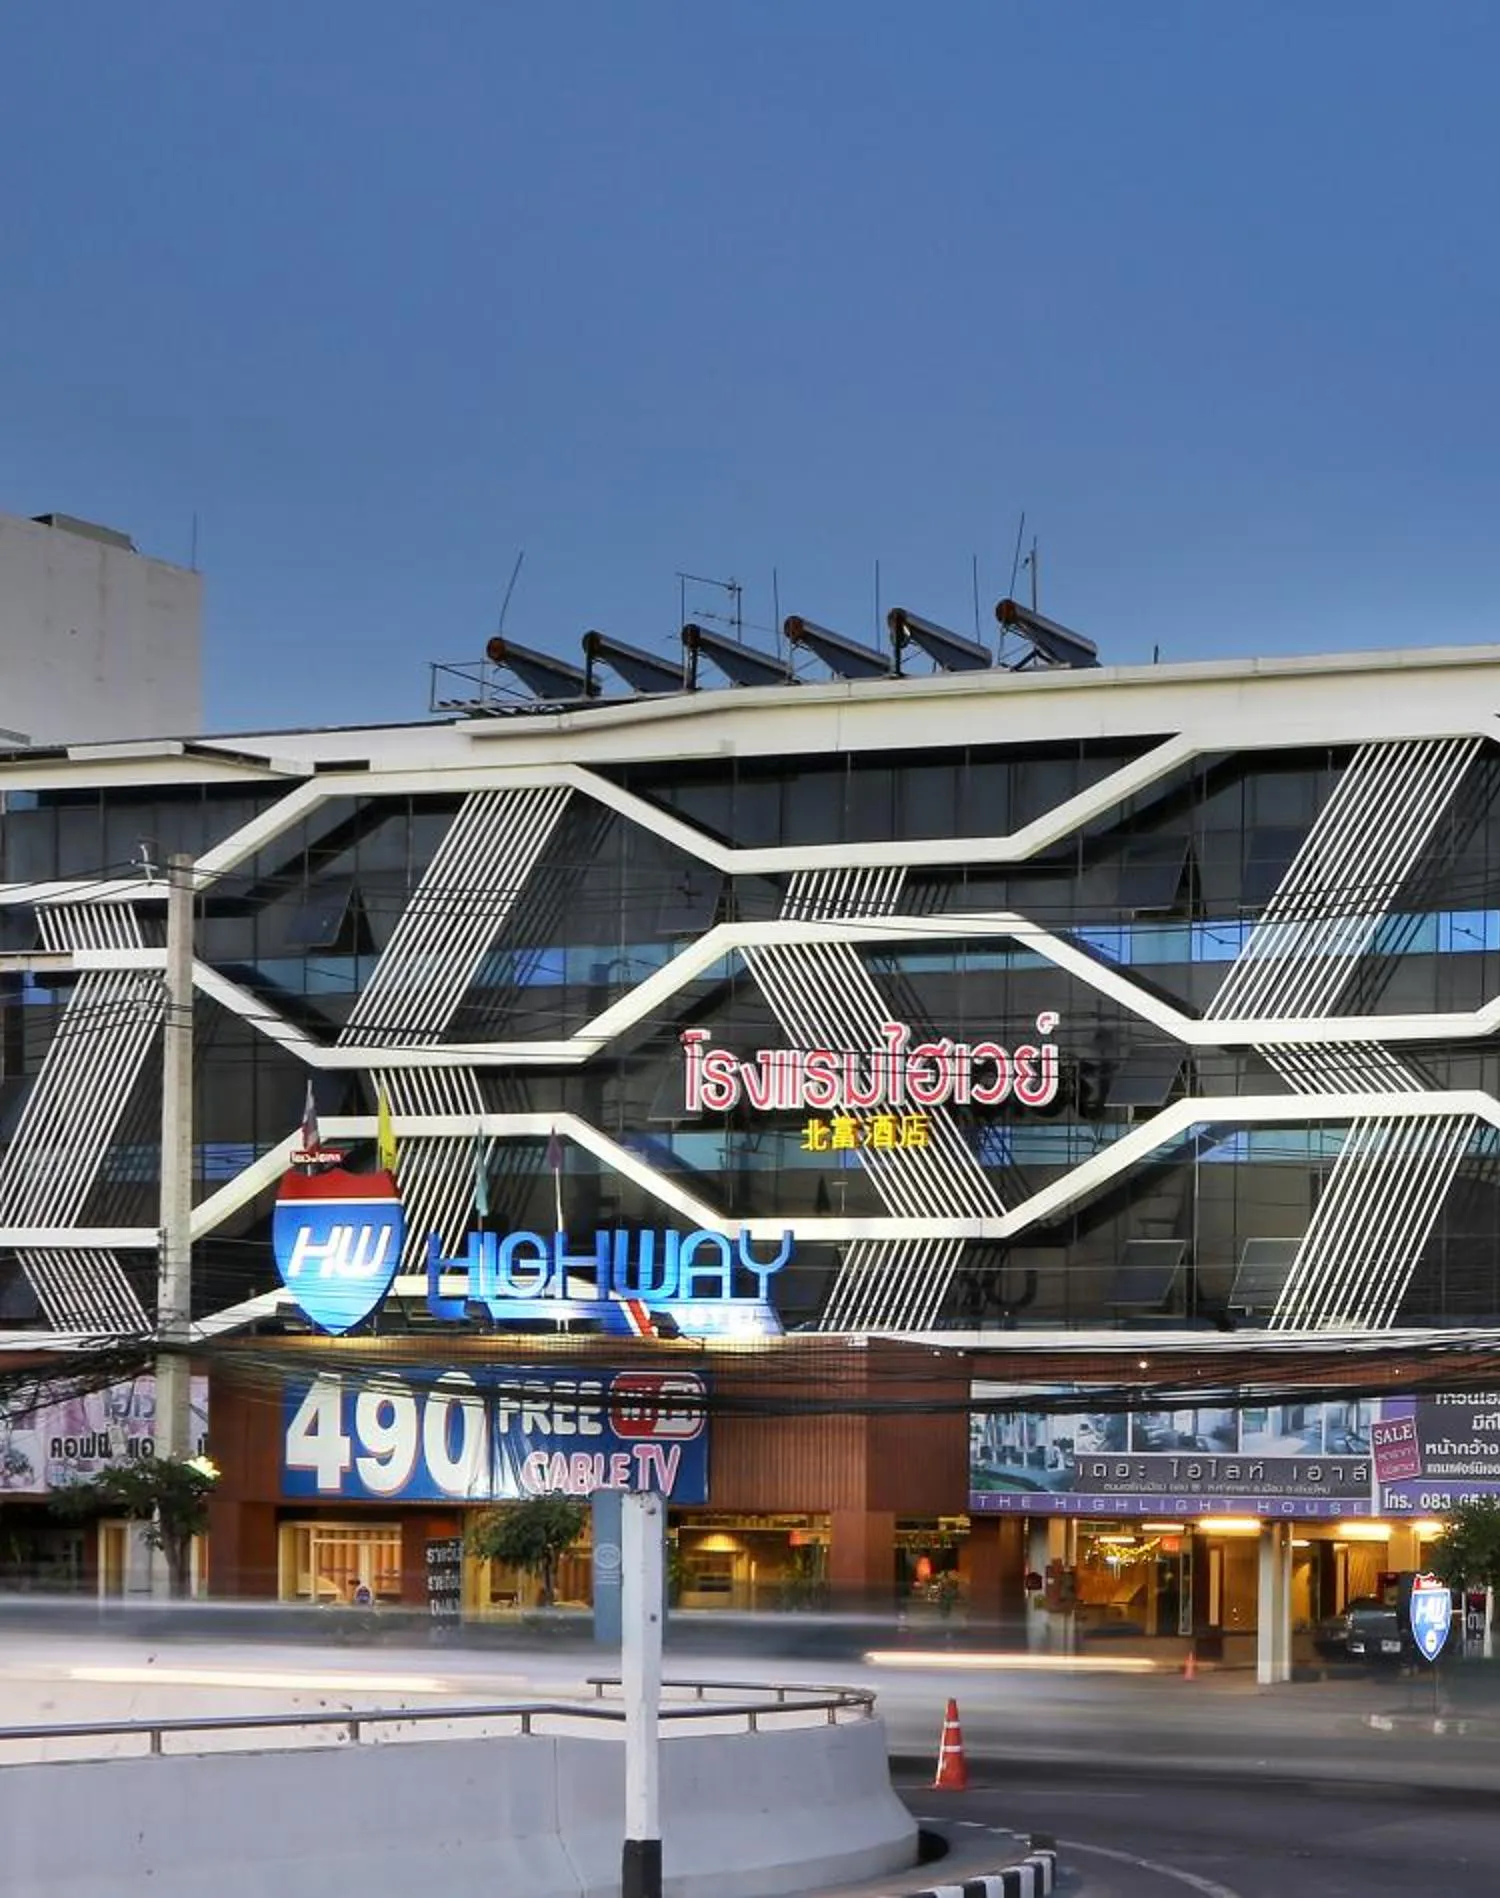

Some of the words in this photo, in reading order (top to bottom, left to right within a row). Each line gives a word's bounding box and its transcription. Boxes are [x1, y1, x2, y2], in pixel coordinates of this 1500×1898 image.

[680, 1012, 1060, 1111] โรงแรมไฮเวย์
[287, 1226, 393, 1279] HW
[427, 1229, 795, 1319] HIGHWAY
[286, 1371, 492, 1494] 490
[501, 1380, 604, 1434] FREE
[1375, 1423, 1413, 1445] SALE
[520, 1450, 632, 1497] CABLE
[632, 1443, 682, 1496] TV
[977, 1496, 1031, 1509] THE
[1055, 1496, 1233, 1511] HIGHLIGHT
[1257, 1501, 1365, 1515] HOUSE
[1420, 1493, 1451, 1510] 083
